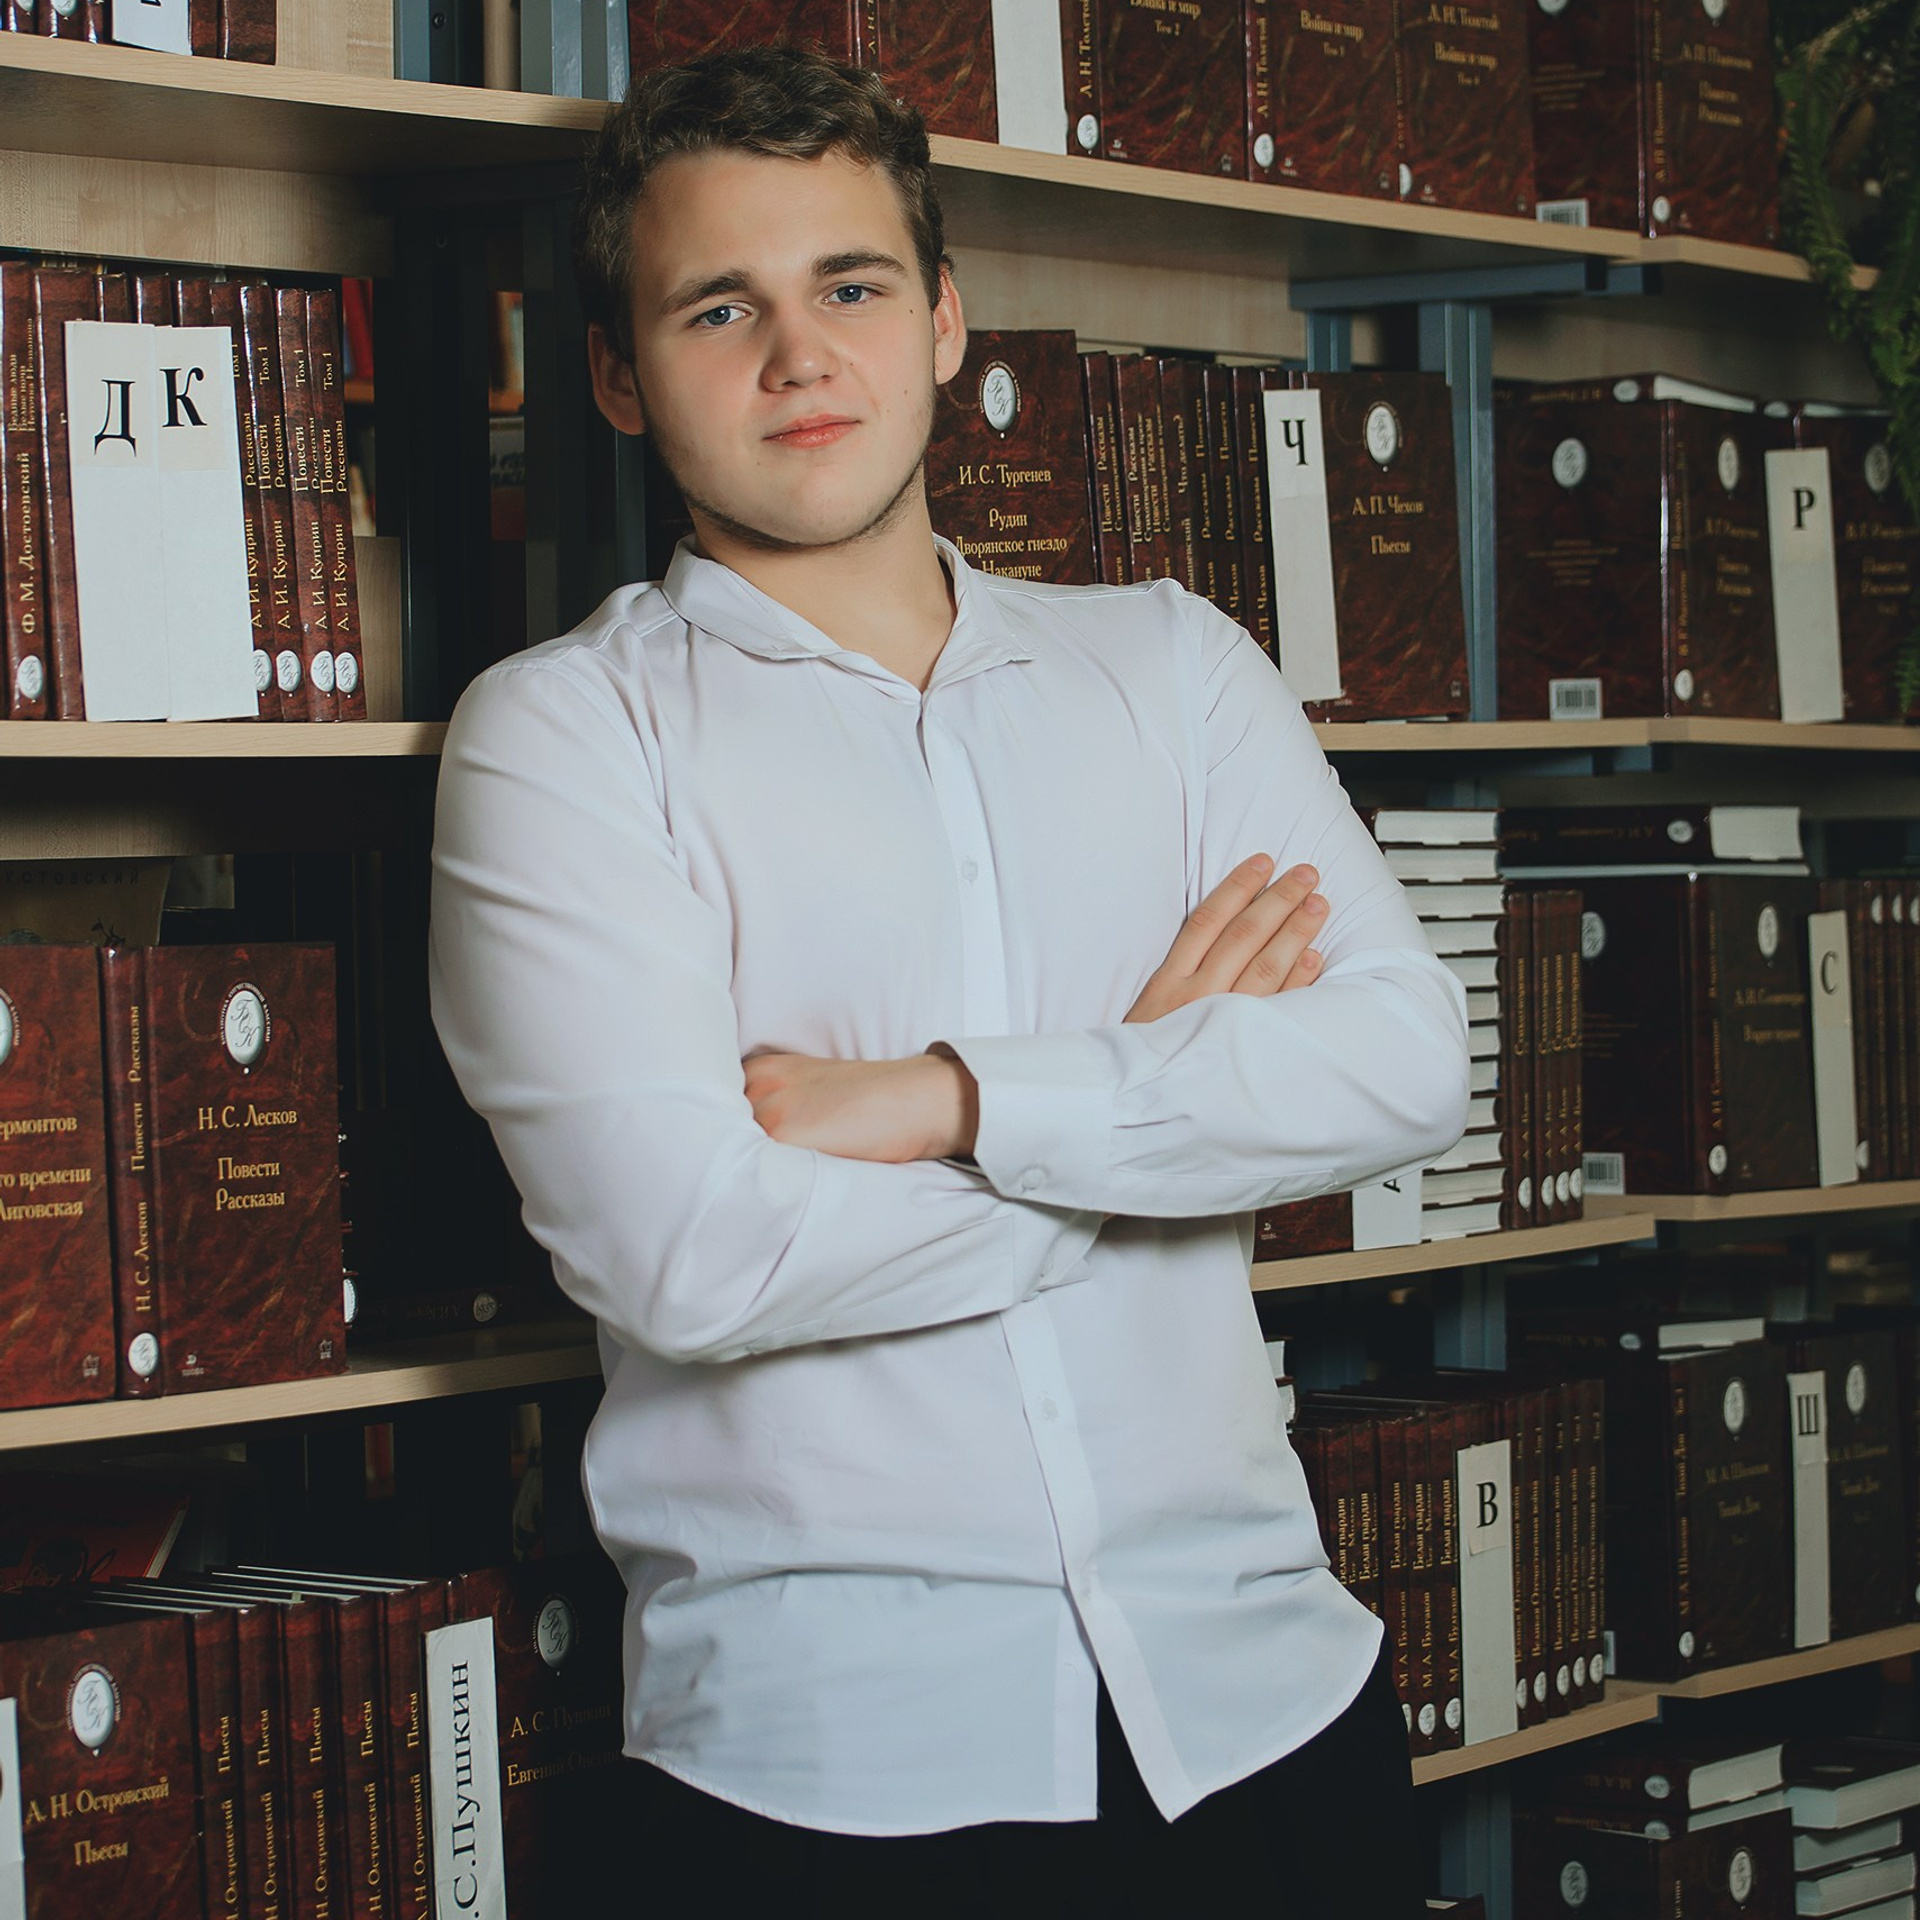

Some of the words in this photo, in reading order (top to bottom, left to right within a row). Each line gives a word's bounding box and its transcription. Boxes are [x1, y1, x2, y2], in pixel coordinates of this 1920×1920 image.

[259, 357, 270, 386] Том
[295, 359, 306, 388] Том
[323, 363, 334, 391] Том
[94, 379, 136, 458] Д
[159, 367, 208, 428] К
[243, 412, 257, 486] Рассказы
[273, 415, 287, 489] Рассказы
[1096, 416, 1108, 471] Рассказы
[1173, 414, 1187, 466] делать?
[1195, 399, 1205, 457] Повести
[1219, 401, 1230, 460] Повести
[1281, 418, 1309, 466] Ч
[258, 424, 272, 490] Повести
[294, 426, 309, 492] Повести
[321, 429, 334, 493] Повести
[336, 420, 348, 493] Рассказы
[959, 466, 976, 485] И.
[979, 465, 994, 484] С.
[997, 464, 1052, 488] Тургенев
[1127, 427, 1138, 482] Рассказы
[1178, 467, 1188, 493] Что
[17, 453, 35, 571] Достоевский
[989, 508, 1028, 532] Рудин
[1101, 484, 1113, 532] Повести
[1132, 494, 1144, 543] Повести
[1201, 473, 1212, 538] Рассказы
[1225, 475, 1235, 541] Рассказы
[1253, 477, 1264, 543] Рассказы
[1352, 498, 1367, 516] А.
[1369, 496, 1386, 515] П.
[1387, 494, 1424, 515] Чехов
[1793, 487, 1815, 530] Р
[245, 518, 259, 578] Куприн
[273, 520, 288, 580] Куприн
[310, 521, 325, 581] Куприн
[333, 523, 348, 582] Куприн
[956, 536, 1025, 559] Дворянское
[1027, 537, 1067, 552] гнездо
[1371, 535, 1411, 554] Пьесы
[20, 575, 35, 603] М.
[982, 560, 1042, 580] Накануне
[1229, 563, 1239, 608] Чехов
[1257, 565, 1268, 609] Чехов
[251, 609, 263, 628] А.
[275, 584, 289, 605] И.
[313, 585, 325, 606] И.
[335, 587, 348, 608] И.
[21, 606, 36, 635] Ф.
[278, 610, 291, 629] А.
[315, 610, 328, 630] А.
[337, 612, 350, 631] А.
[1821, 950, 1839, 996] С
[127, 1006, 142, 1084] Рассказы
[131, 1103, 145, 1172] Повести
[198, 1107, 218, 1131] Н.
[221, 1105, 241, 1128] С.
[243, 1104, 297, 1128] Лесков
[19, 1168, 91, 1192] времени
[217, 1157, 280, 1180] Повести
[215, 1188, 285, 1211] Рассказы
[134, 1201, 149, 1262] Лесков
[135, 1265, 151, 1288] С.
[136, 1292, 152, 1313] Н.
[1797, 1393, 1819, 1436] Ш
[1476, 1481, 1499, 1529] В
[257, 1709, 270, 1766] Пьесы
[309, 1706, 323, 1764] Пьесы
[360, 1700, 374, 1757] Пьесы
[407, 1692, 420, 1748] Пьесы
[510, 1716, 529, 1738] А.
[217, 1715, 231, 1774] Пьесы
[507, 1757, 567, 1787] Евгений
[25, 1800, 47, 1825] А.
[50, 1792, 73, 1819] Н.
[76, 1775, 170, 1815] Островский
[409, 1772, 426, 1876] Островский
[74, 1839, 129, 1866] Пьесы
[221, 1799, 239, 1905] Островский
[260, 1791, 278, 1896] Островский
[312, 1788, 328, 1893] Островский
[363, 1782, 381, 1886] Островский
[368, 1888, 382, 1912] Н.
[415, 1879, 428, 1902] Н.
